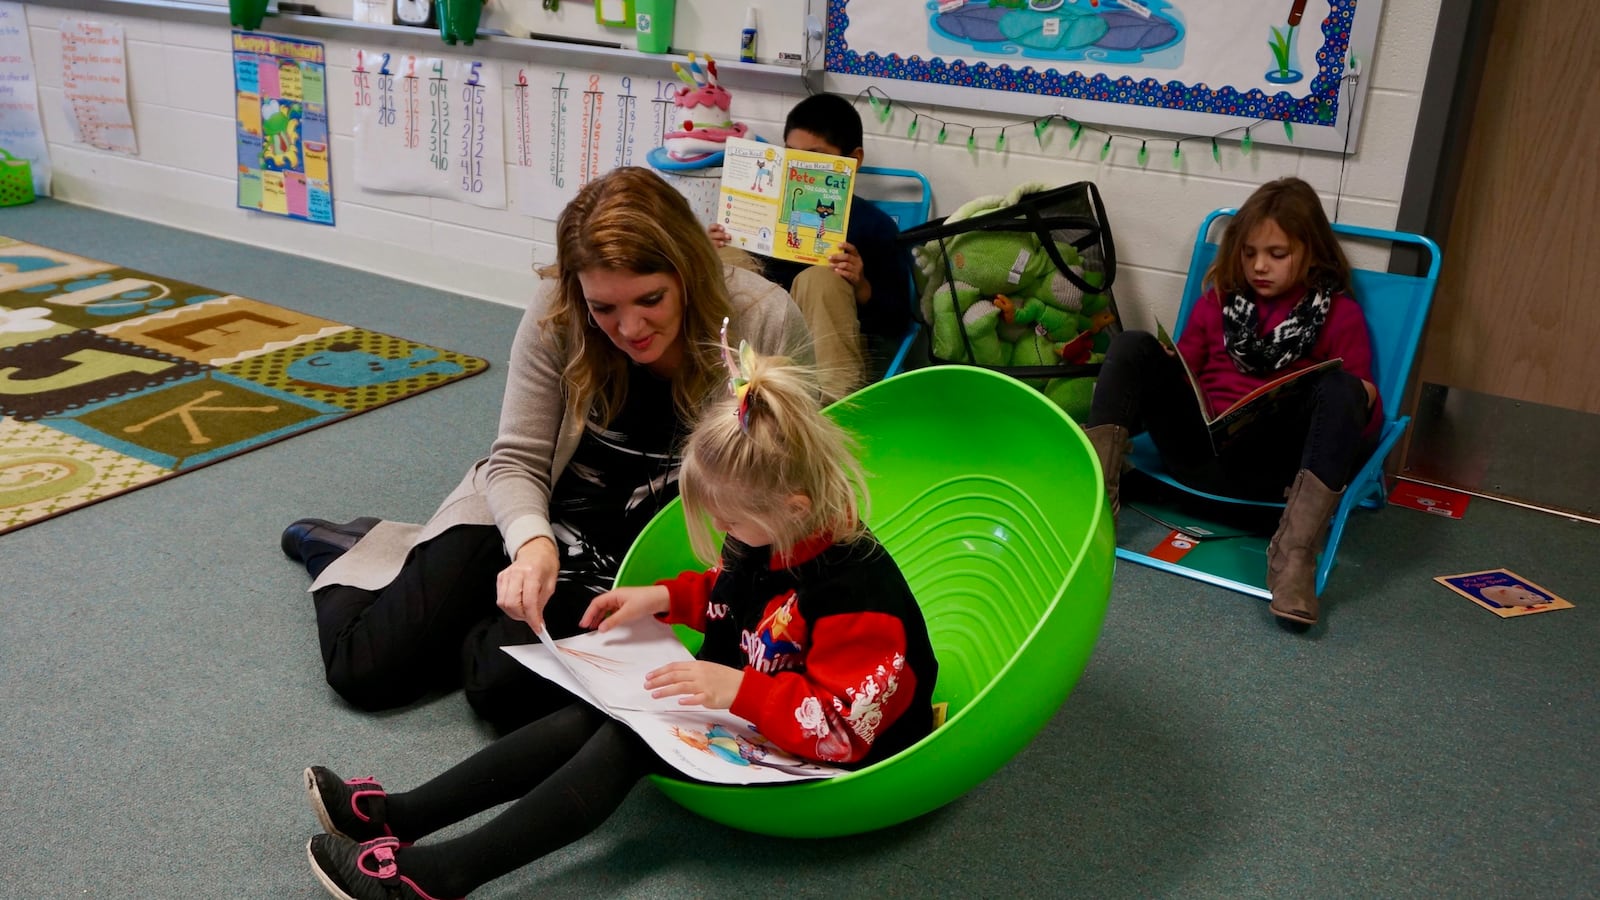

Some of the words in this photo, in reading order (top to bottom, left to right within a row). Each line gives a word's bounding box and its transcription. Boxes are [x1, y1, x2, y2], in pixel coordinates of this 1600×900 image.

[234, 34, 266, 52] Happy
[356, 50, 364, 72] 1
[380, 53, 391, 74] 2
[408, 56, 416, 77] 3
[432, 60, 443, 78] 4
[467, 62, 482, 84] 5
[518, 69, 527, 84] 6
[556, 72, 565, 88] 7
[354, 76, 360, 86] 0
[364, 76, 370, 88] 1
[378, 78, 384, 90] 0
[387, 78, 394, 92] 2
[403, 78, 409, 92] 0
[413, 80, 418, 94] 3
[589, 74, 600, 92] 8
[622, 76, 631, 96] 9
[654, 80, 677, 100] 10
[430, 82, 437, 96] 0
[440, 84, 448, 99] 4
[462, 88, 470, 102] 0
[475, 90, 484, 104] 5
[354, 92, 361, 106] 1
[364, 92, 371, 106] 0
[379, 95, 386, 109] 1
[388, 96, 396, 112] 1
[404, 99, 410, 113] 1
[413, 100, 420, 114] 2
[618, 97, 624, 108] 0
[630, 98, 636, 110] 9
[431, 101, 436, 116] 1
[443, 102, 448, 116] 3
[464, 106, 470, 120] 1
[476, 106, 484, 123] 4
[378, 110, 386, 124] 2
[388, 112, 396, 124] 0
[404, 116, 410, 130] 2
[414, 116, 420, 132] 1
[430, 119, 437, 134] 2
[442, 120, 450, 136] 2
[462, 124, 470, 139] 2
[476, 124, 484, 140] 3
[618, 120, 624, 132] 2
[628, 122, 635, 132] 7
[404, 132, 410, 147] 3
[413, 134, 420, 148] 0
[429, 136, 437, 151] 3
[443, 140, 448, 154] 1
[616, 132, 622, 144] 3
[628, 134, 634, 144] 6
[460, 141, 468, 157] 3
[474, 142, 484, 158] 2
[616, 144, 622, 156] 4
[626, 146, 632, 156] 5
[430, 154, 438, 170] 4
[441, 158, 448, 170] 0
[460, 160, 468, 176] 4
[476, 160, 482, 176] 1
[462, 176, 470, 191] 5
[474, 179, 482, 192] 0
[789, 168, 815, 184] Pete
[825, 175, 846, 190] Cat
[142, 310, 299, 352] E
[123, 390, 279, 445] K
